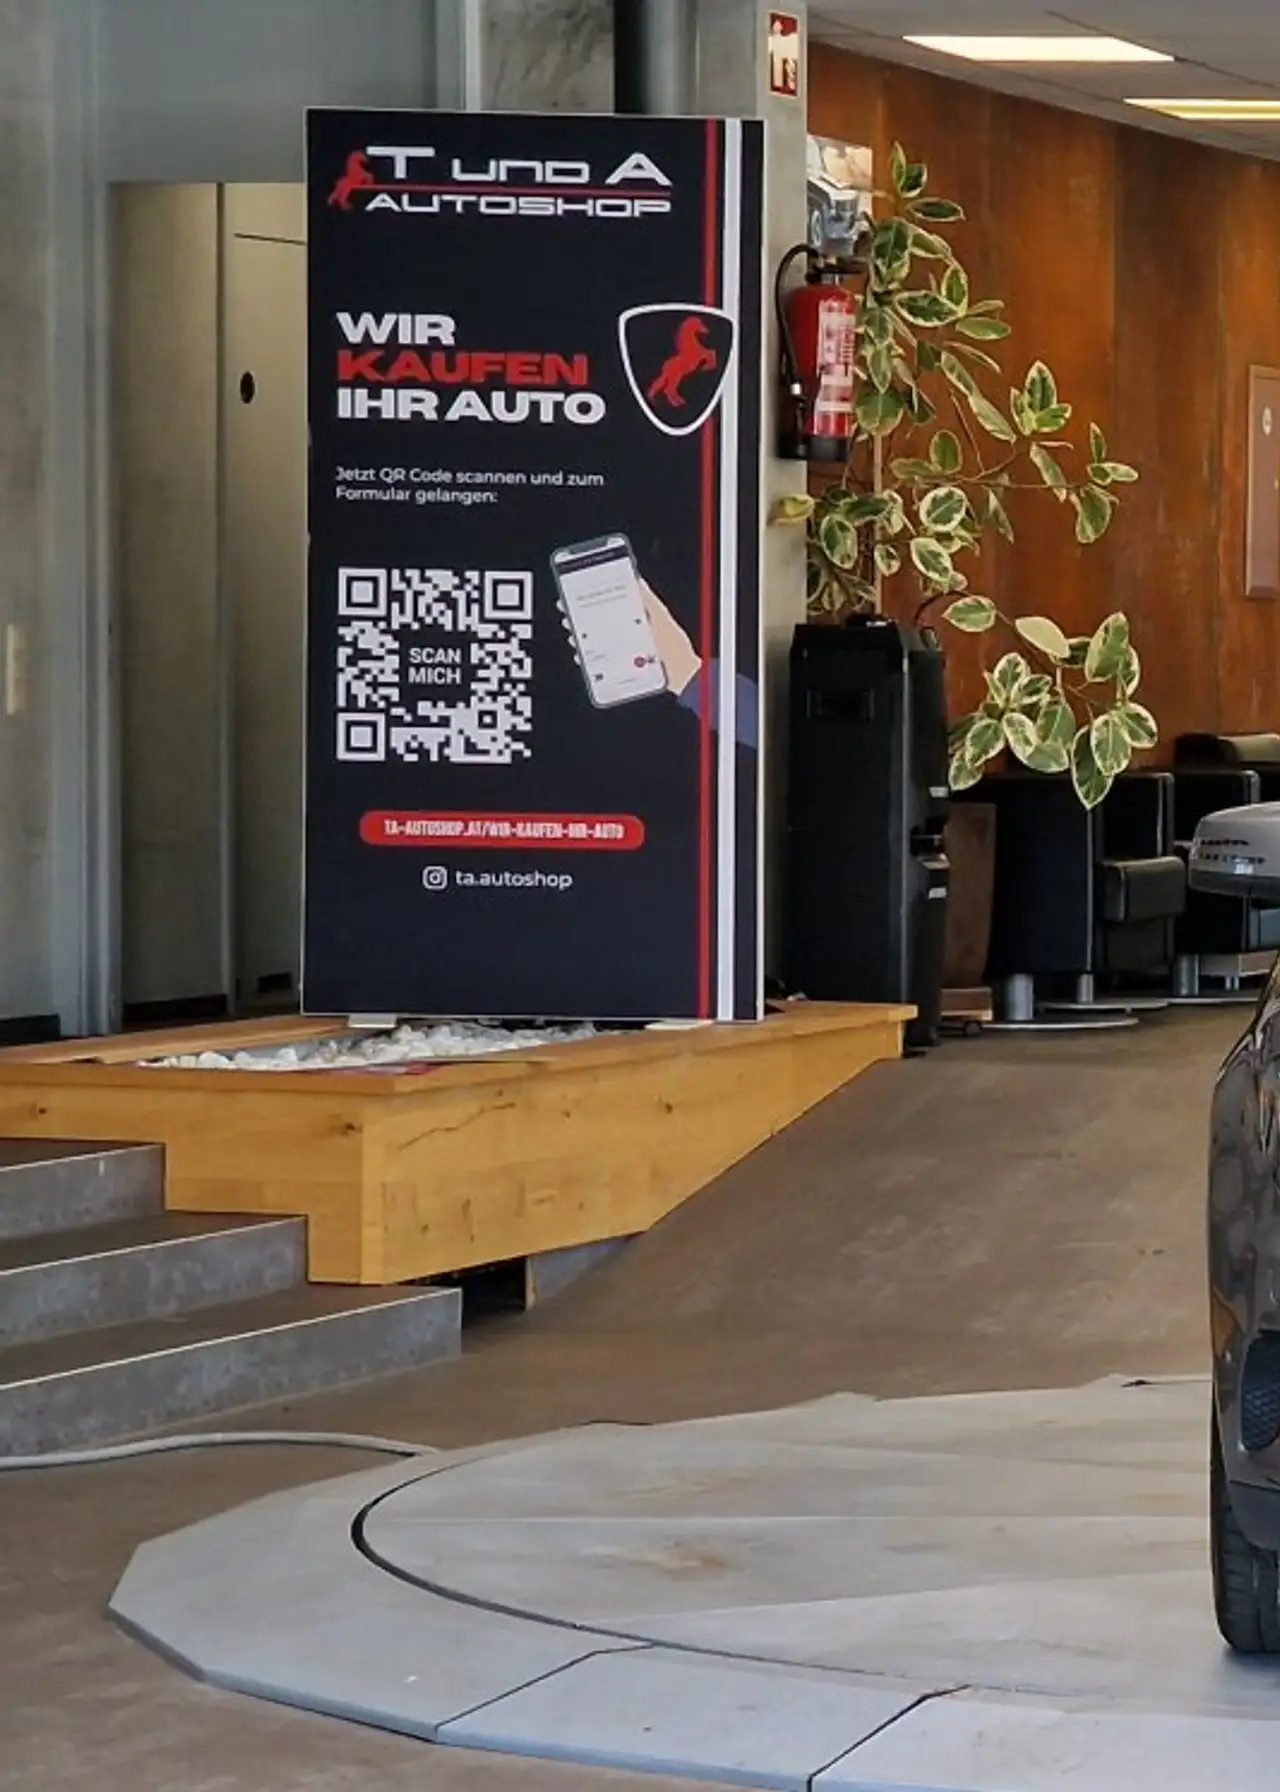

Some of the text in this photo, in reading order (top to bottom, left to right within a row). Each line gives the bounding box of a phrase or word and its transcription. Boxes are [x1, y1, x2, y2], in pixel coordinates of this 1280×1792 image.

[366, 146, 435, 180] T
[605, 152, 672, 186] A
[365, 193, 671, 218] AUTOSHOP
[335, 312, 456, 346] WIR
[337, 350, 589, 386] KAUFEN
[337, 388, 606, 425] IHR AUTO
[335, 466, 605, 487] Jetzt QR Code scannen und zum
[335, 486, 499, 505] Formular gelangen:
[408, 647, 462, 666] SCAN
[408, 667, 462, 686] MICH
[455, 869, 573, 890] ta.autoshop
